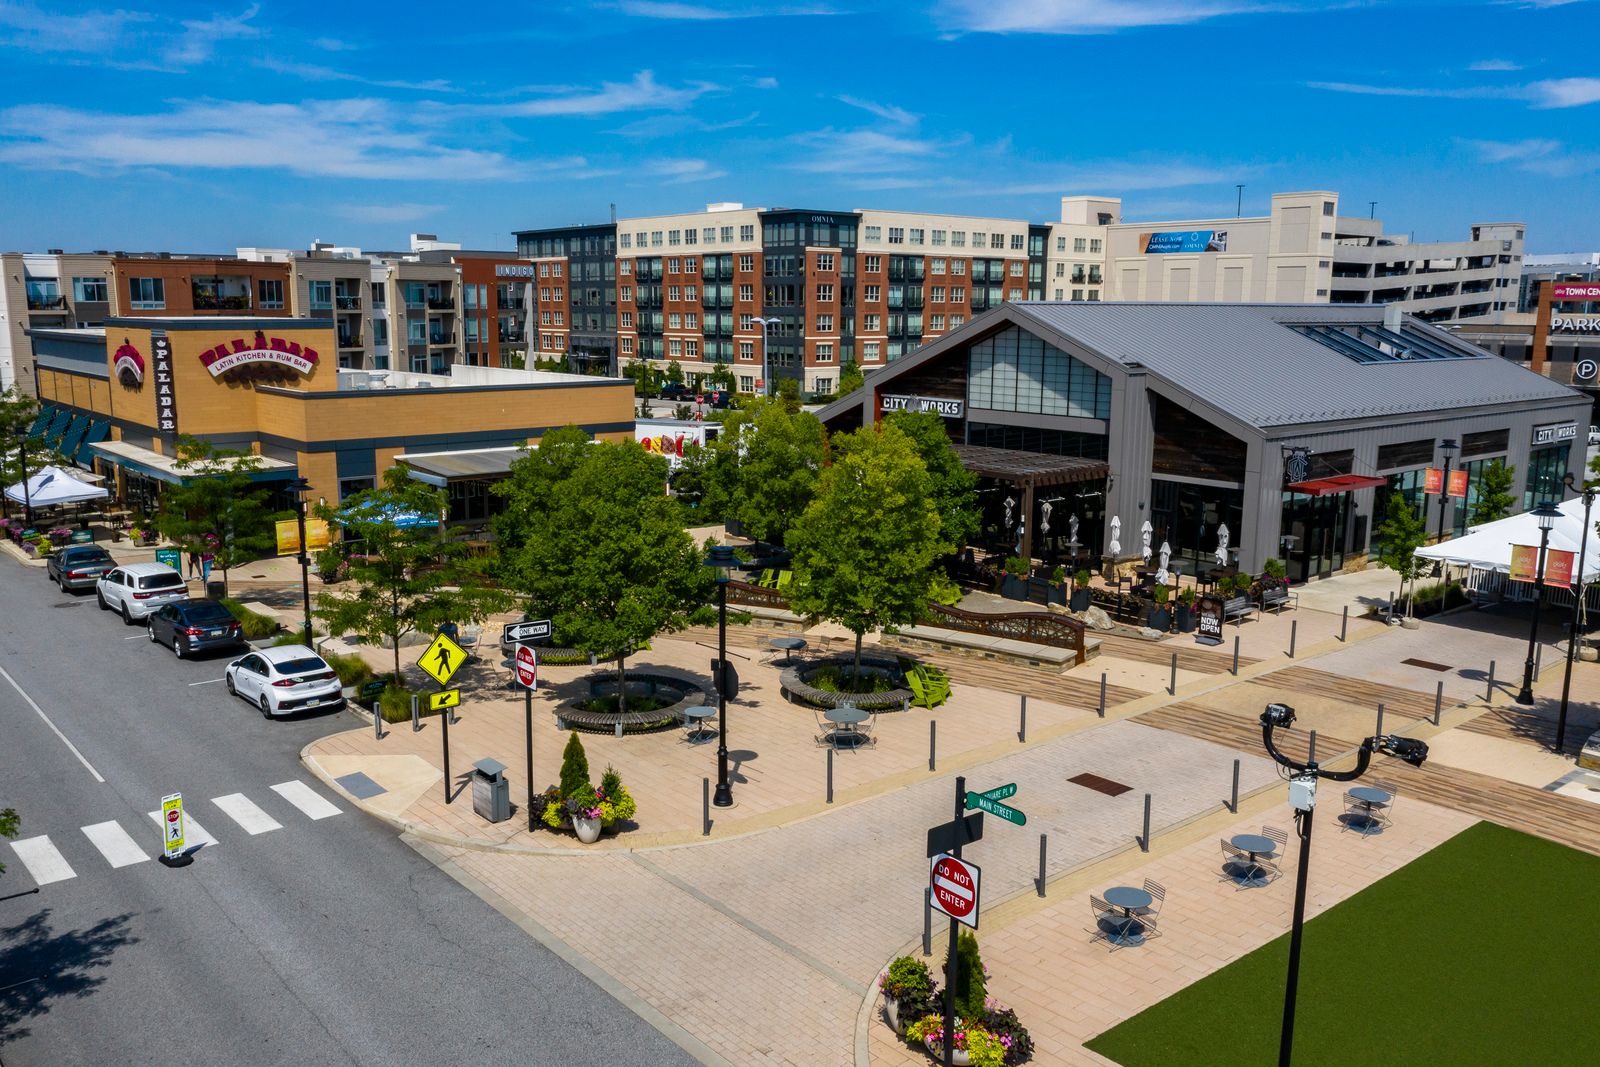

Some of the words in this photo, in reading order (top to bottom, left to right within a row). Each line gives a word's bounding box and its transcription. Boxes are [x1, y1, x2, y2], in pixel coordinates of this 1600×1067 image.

[811, 215, 834, 223] OMNIA
[500, 266, 534, 276] INDIGO
[1565, 287, 1587, 296] TOWN
[199, 336, 319, 369] PALADAR
[215, 358, 235, 372] LATIN
[236, 352, 267, 363] KITCHEN
[276, 353, 292, 363] RUM
[293, 358, 308, 369] BAR
[156, 349, 175, 430] PALADAR
[883, 397, 908, 410] CITY
[920, 400, 959, 414] WORKS
[1538, 429, 1553, 441] CITY
[1201, 616, 1219, 626] NOW
[519, 626, 532, 636] ONE
[533, 624, 546, 633] WAY
[1201, 623, 1220, 634] OPEN
[518, 651, 525, 660] DO
[525, 655, 533, 664] NOT
[520, 669, 532, 680] ENTER
[979, 798, 992, 811] MAIN
[993, 803, 1013, 820] STREET
[938, 863, 950, 877] DO
[953, 872, 971, 887] NOT
[940, 889, 966, 911] ENTER
